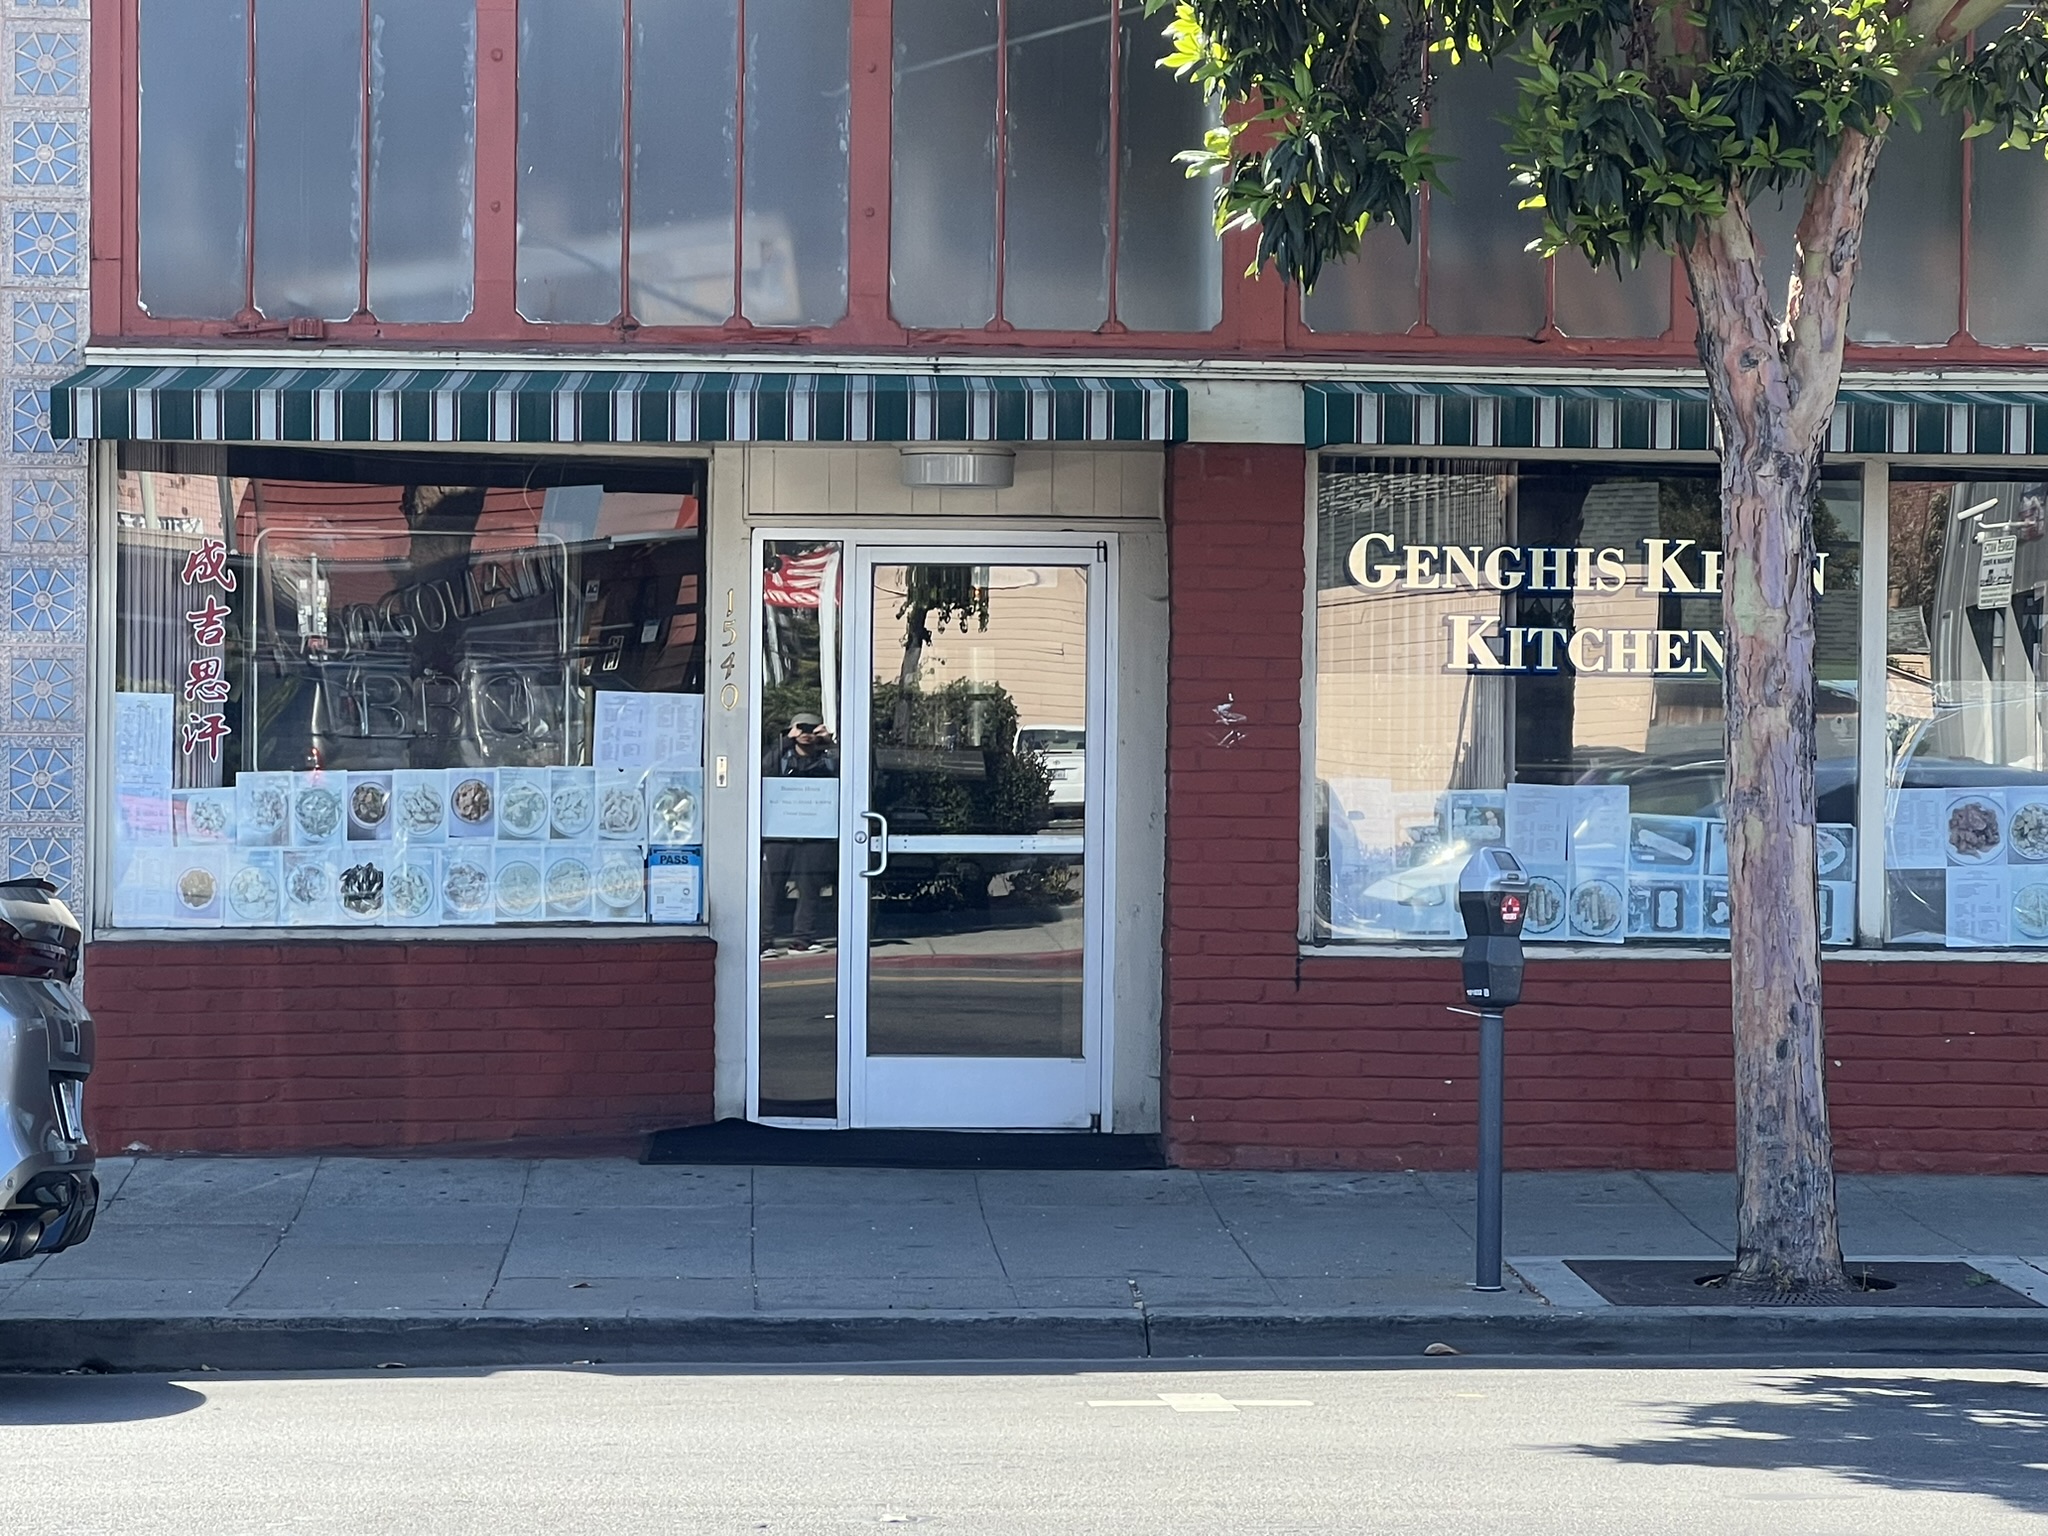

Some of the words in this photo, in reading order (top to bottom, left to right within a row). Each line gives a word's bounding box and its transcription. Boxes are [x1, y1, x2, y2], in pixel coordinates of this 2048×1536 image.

[1347, 532, 1627, 592] GENGHIS
[1642, 538, 1830, 596] KH
[181, 537, 238, 763] 成吉思汗
[719, 588, 740, 712] 1540
[1447, 614, 1725, 674] KITCHEN
[660, 855, 689, 865] PASS
